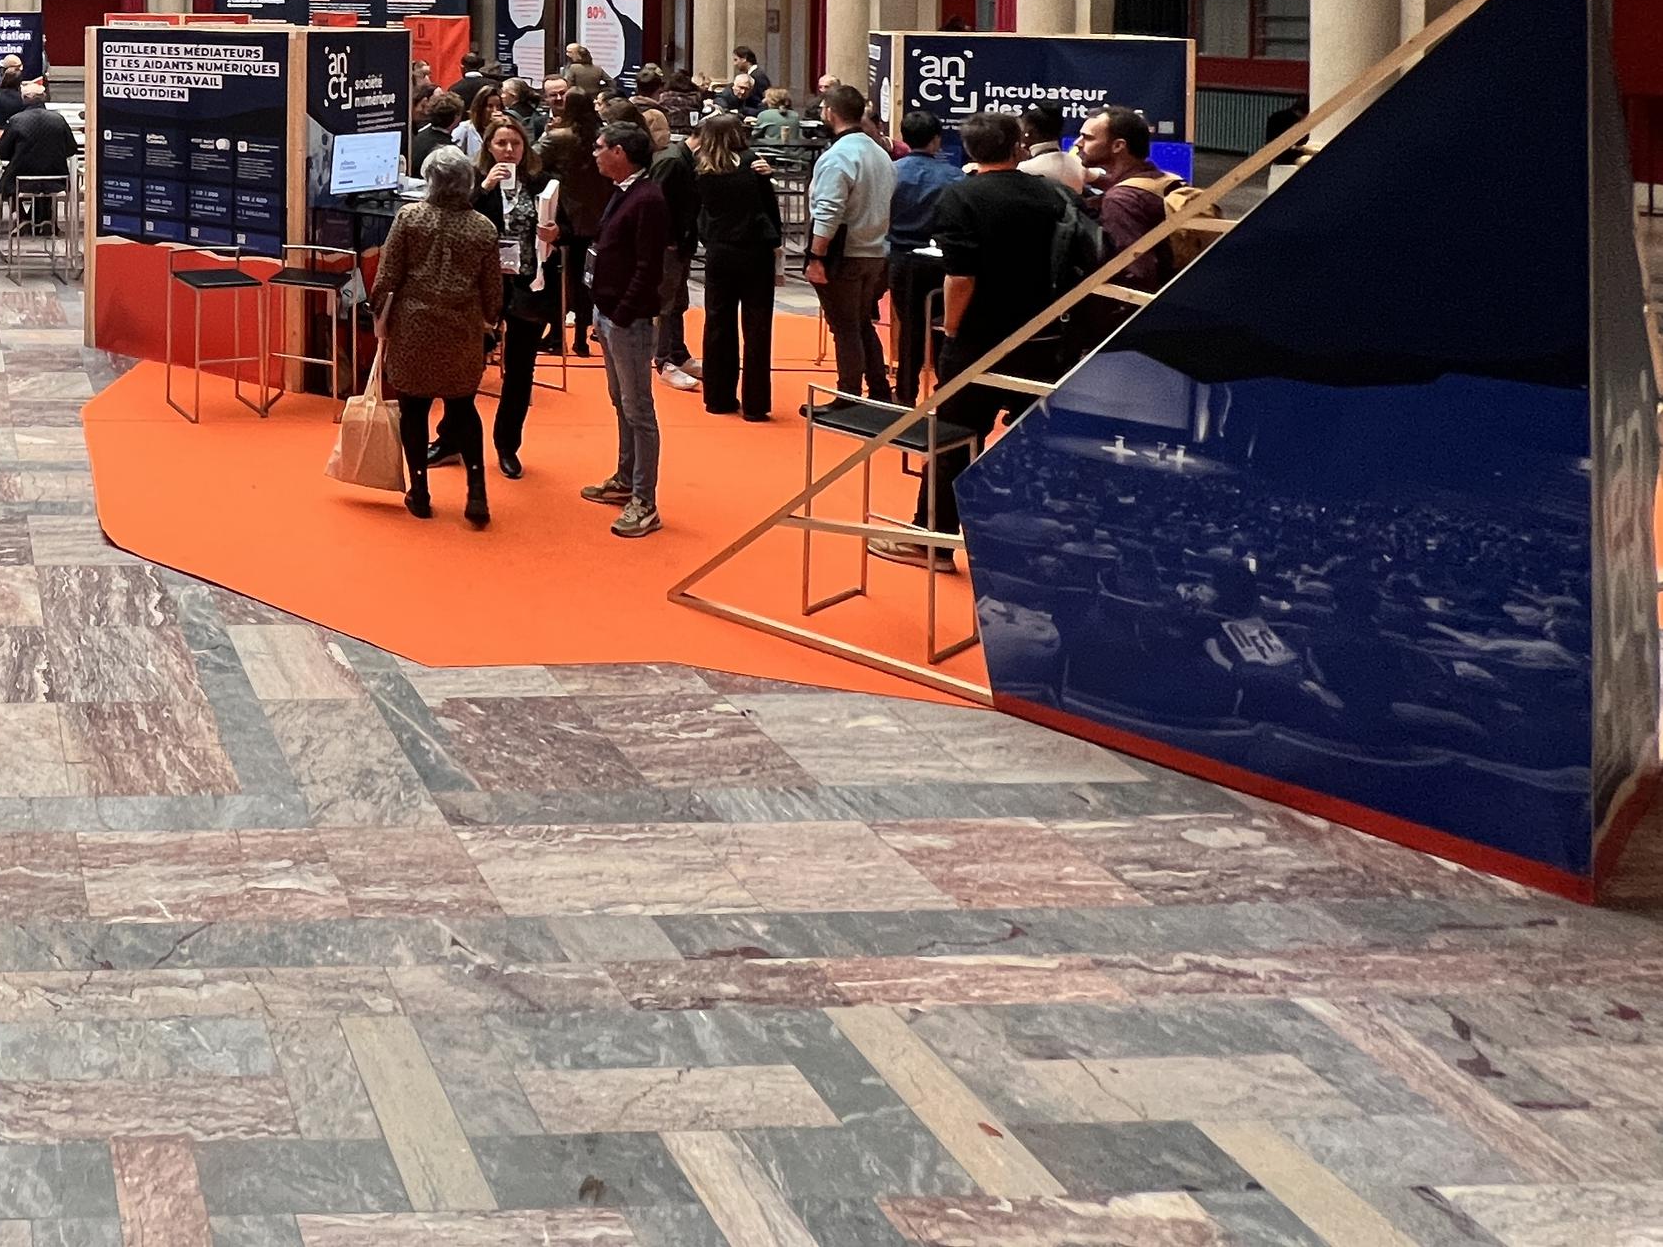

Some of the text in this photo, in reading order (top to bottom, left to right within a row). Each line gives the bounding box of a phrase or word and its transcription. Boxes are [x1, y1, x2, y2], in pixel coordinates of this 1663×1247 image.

[587, 5, 607, 19] 80%
[105, 44, 261, 59] OUTILLER LES MÉDIATEURS
[105, 58, 277, 76] ET LES AIDANTS NUMÉRIQUES
[328, 52, 348, 76] an
[919, 55, 966, 79] an
[105, 72, 220, 87] DANS LEUR TRAVAIL
[328, 73, 348, 100] ct
[354, 74, 383, 90] société
[105, 86, 186, 99] AU QUOTIDIEN
[919, 75, 965, 102] ct
[984, 82, 1107, 102] incubateur
[354, 91, 396, 108] numérique
[984, 100, 1023, 117] des
